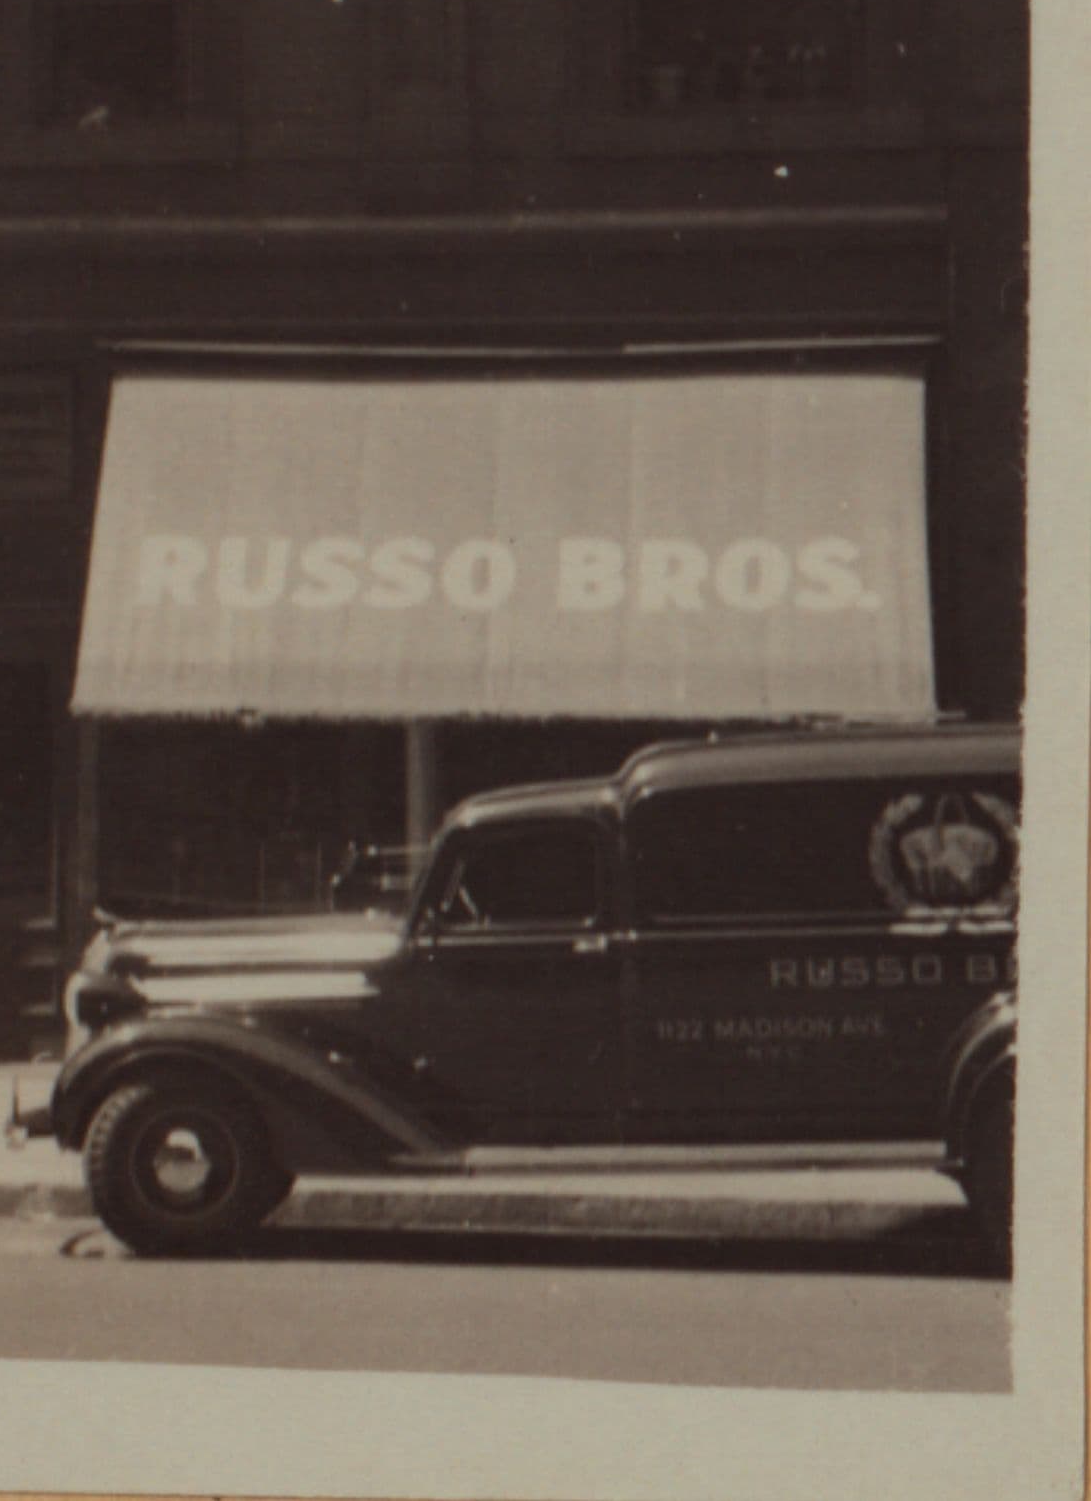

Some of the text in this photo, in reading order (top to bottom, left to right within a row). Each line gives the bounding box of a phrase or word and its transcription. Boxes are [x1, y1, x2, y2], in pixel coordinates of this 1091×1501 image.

[133, 533, 882, 612] RUSSO BROS.
[769, 954, 944, 988] RUSSO
[712, 1015, 834, 1042] MADISON
